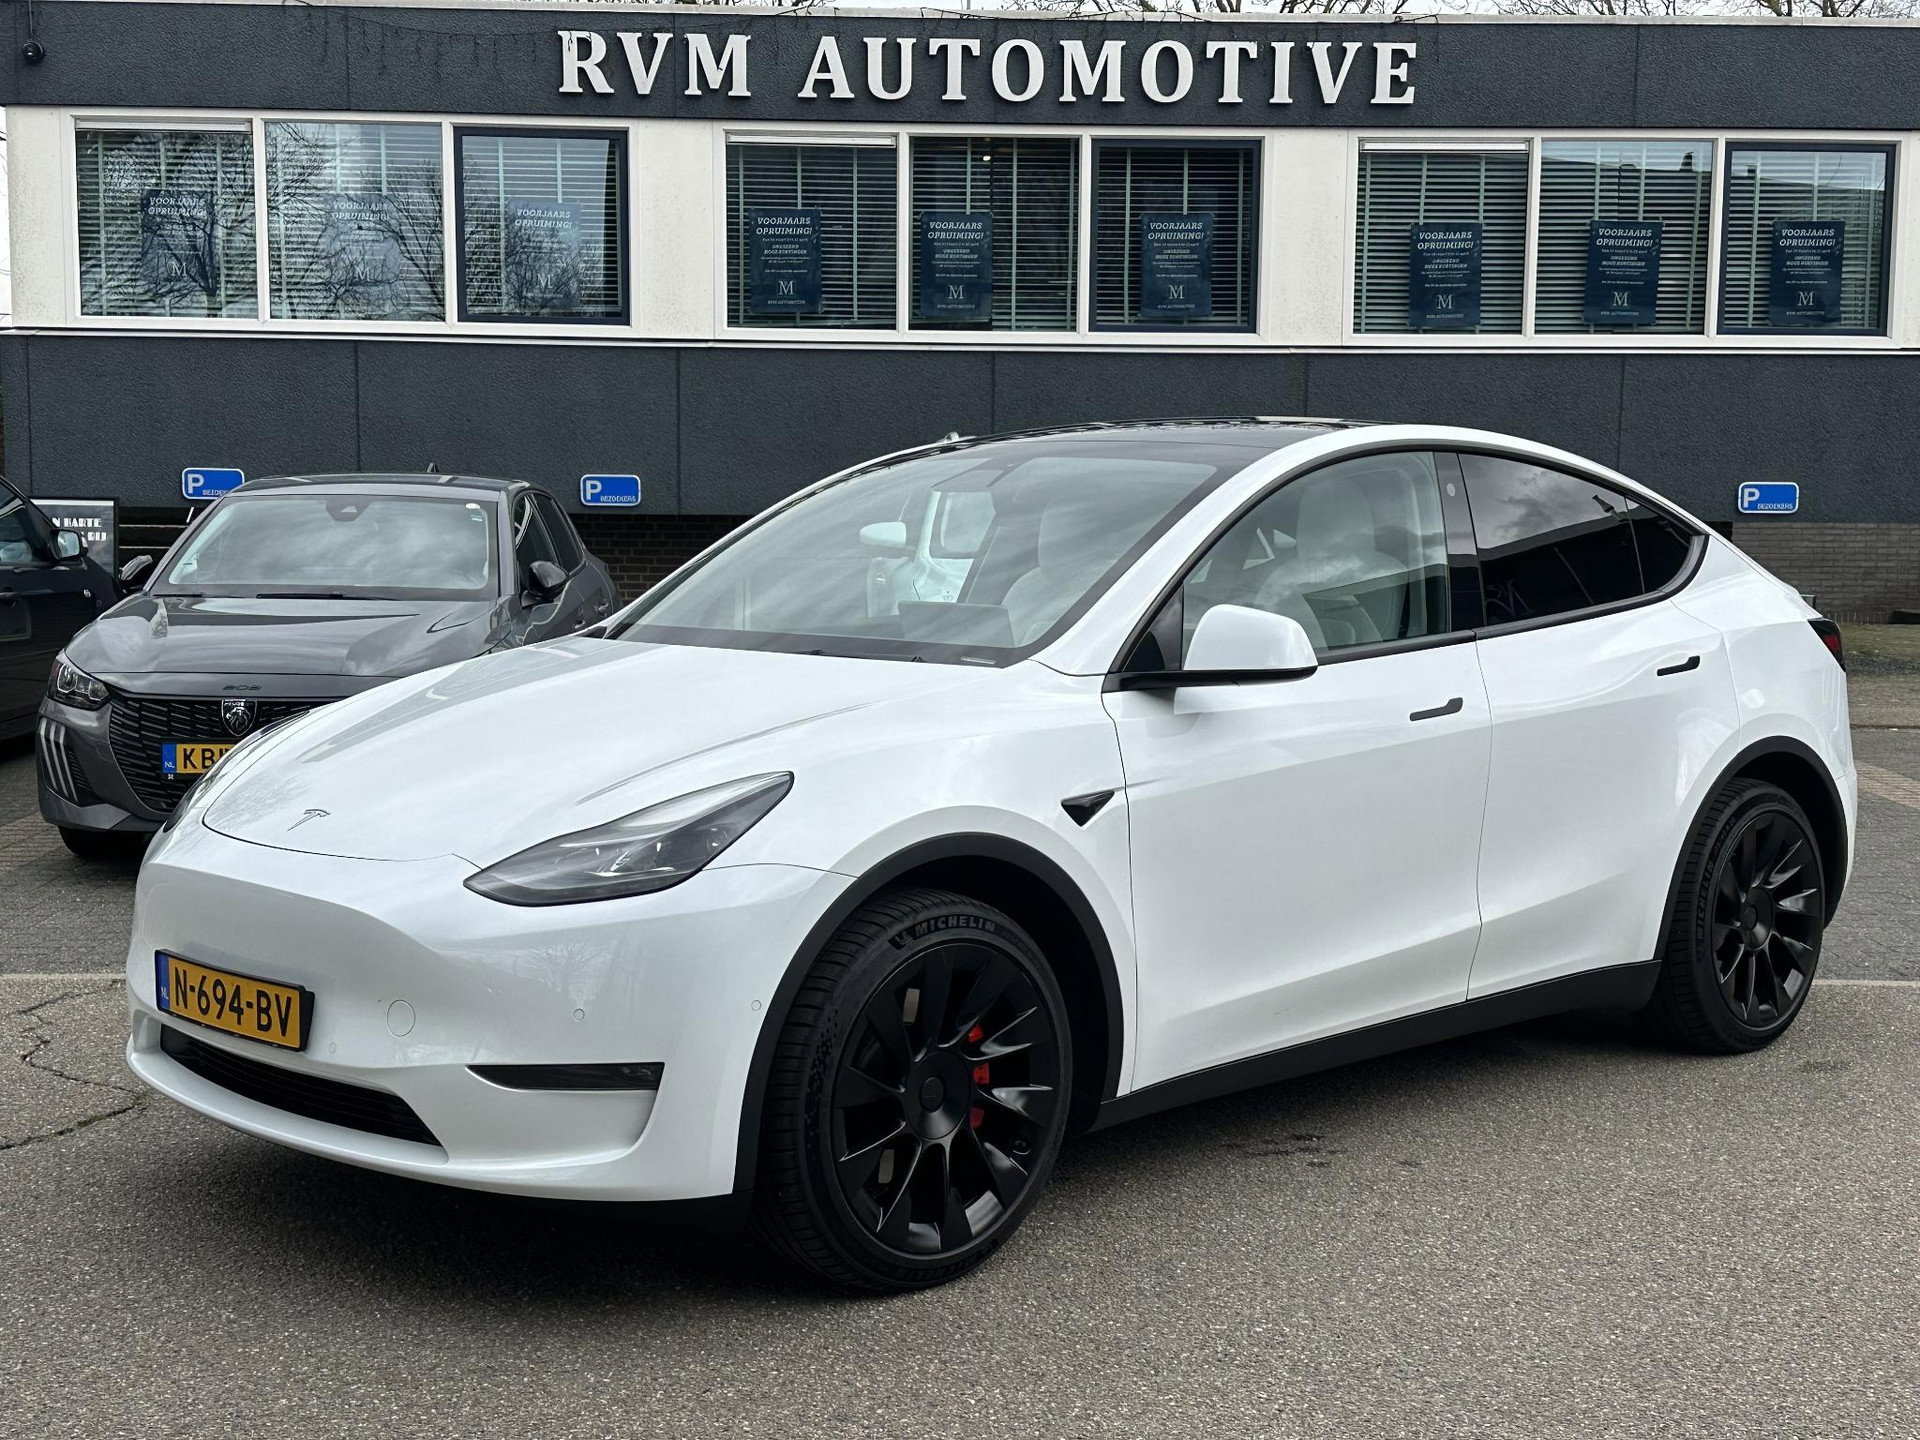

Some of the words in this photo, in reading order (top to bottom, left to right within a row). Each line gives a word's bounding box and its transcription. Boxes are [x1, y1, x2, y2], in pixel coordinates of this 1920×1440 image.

[557, 30, 751, 97] RVM
[798, 36, 1417, 104] AUTOMOTIVE
[517, 209, 571, 218] VOORJAARS
[757, 217, 811, 225] VOORJAARS
[515, 219, 572, 229] OPRUIMING!
[1596, 239, 1653, 247] OPRUIMING!
[188, 473, 204, 493] P
[586, 480, 602, 500] P
[1743, 488, 1760, 508] P
[914, 914, 996, 938] MICHELIN
[160, 986, 169, 1000] NL
[174, 966, 292, 1037] N-694-BV
